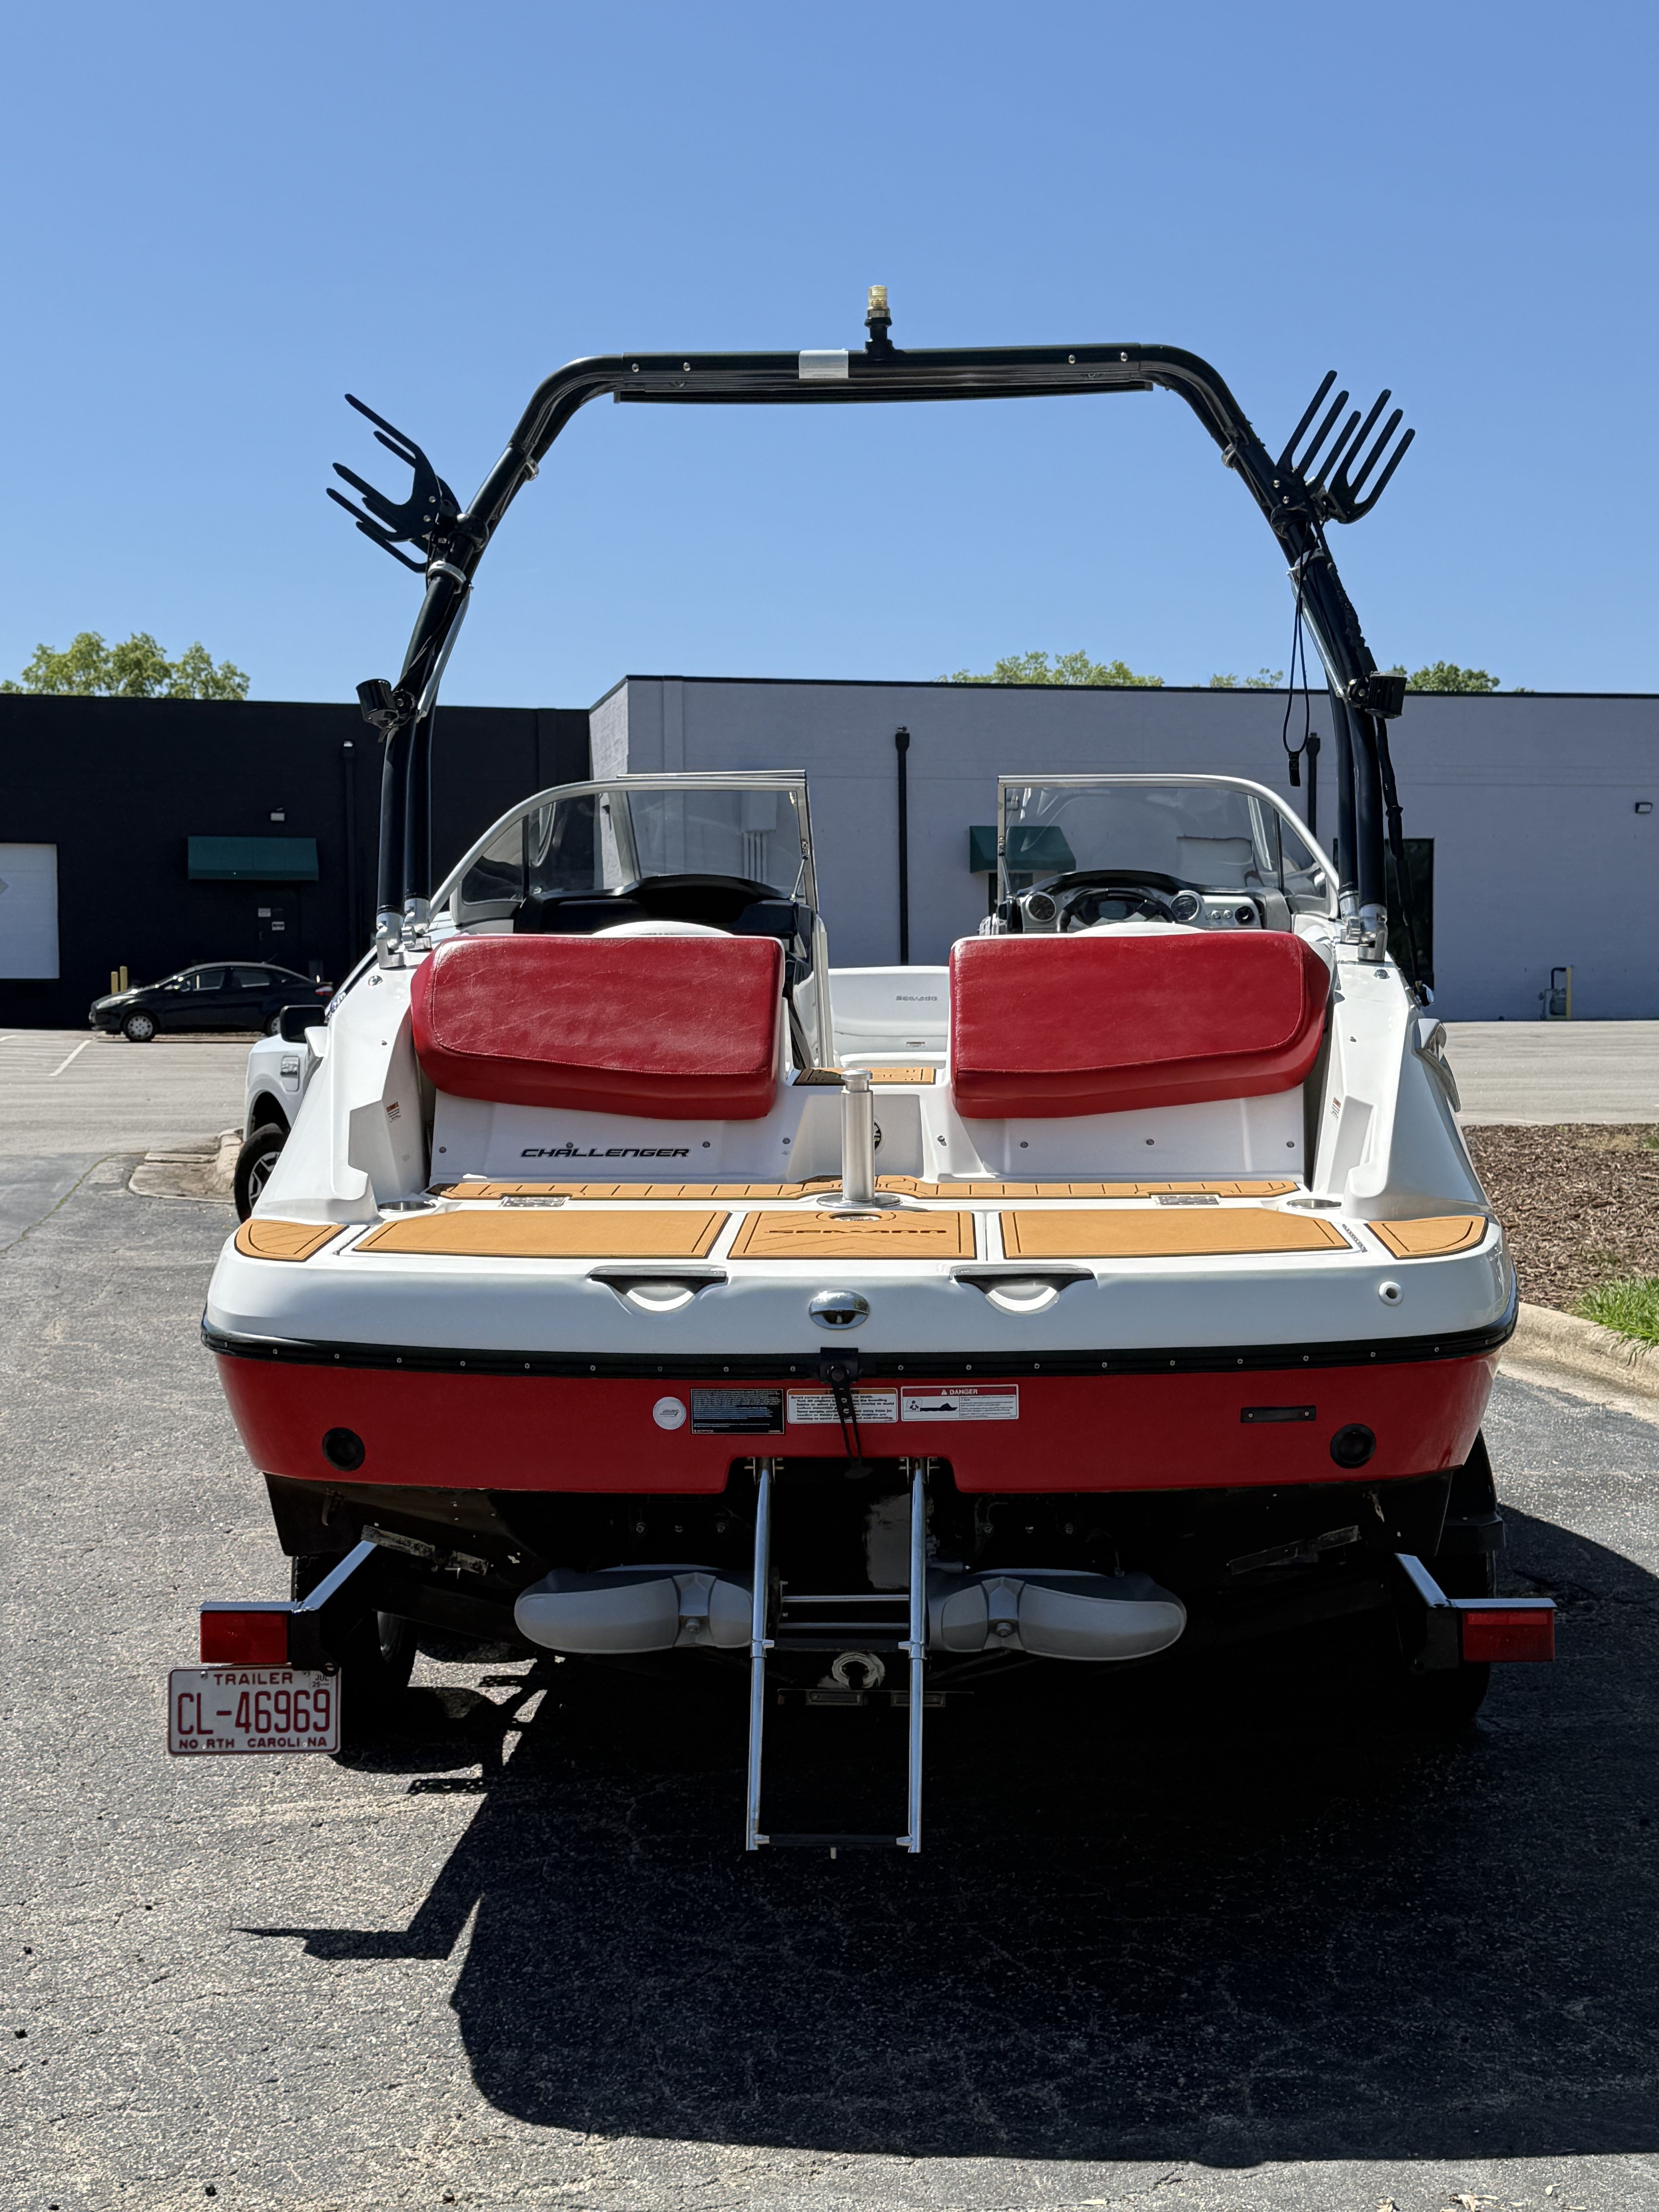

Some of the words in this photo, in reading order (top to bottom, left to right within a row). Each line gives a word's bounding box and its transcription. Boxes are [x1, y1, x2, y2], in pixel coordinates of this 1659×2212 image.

[520, 1148, 690, 1158] CHALLENGER
[214, 1672, 293, 1686] TRAILER
[177, 1689, 331, 1735] CL-46969
[179, 1738, 235, 1749] NORTH
[247, 1736, 327, 1748] CAROLINA
